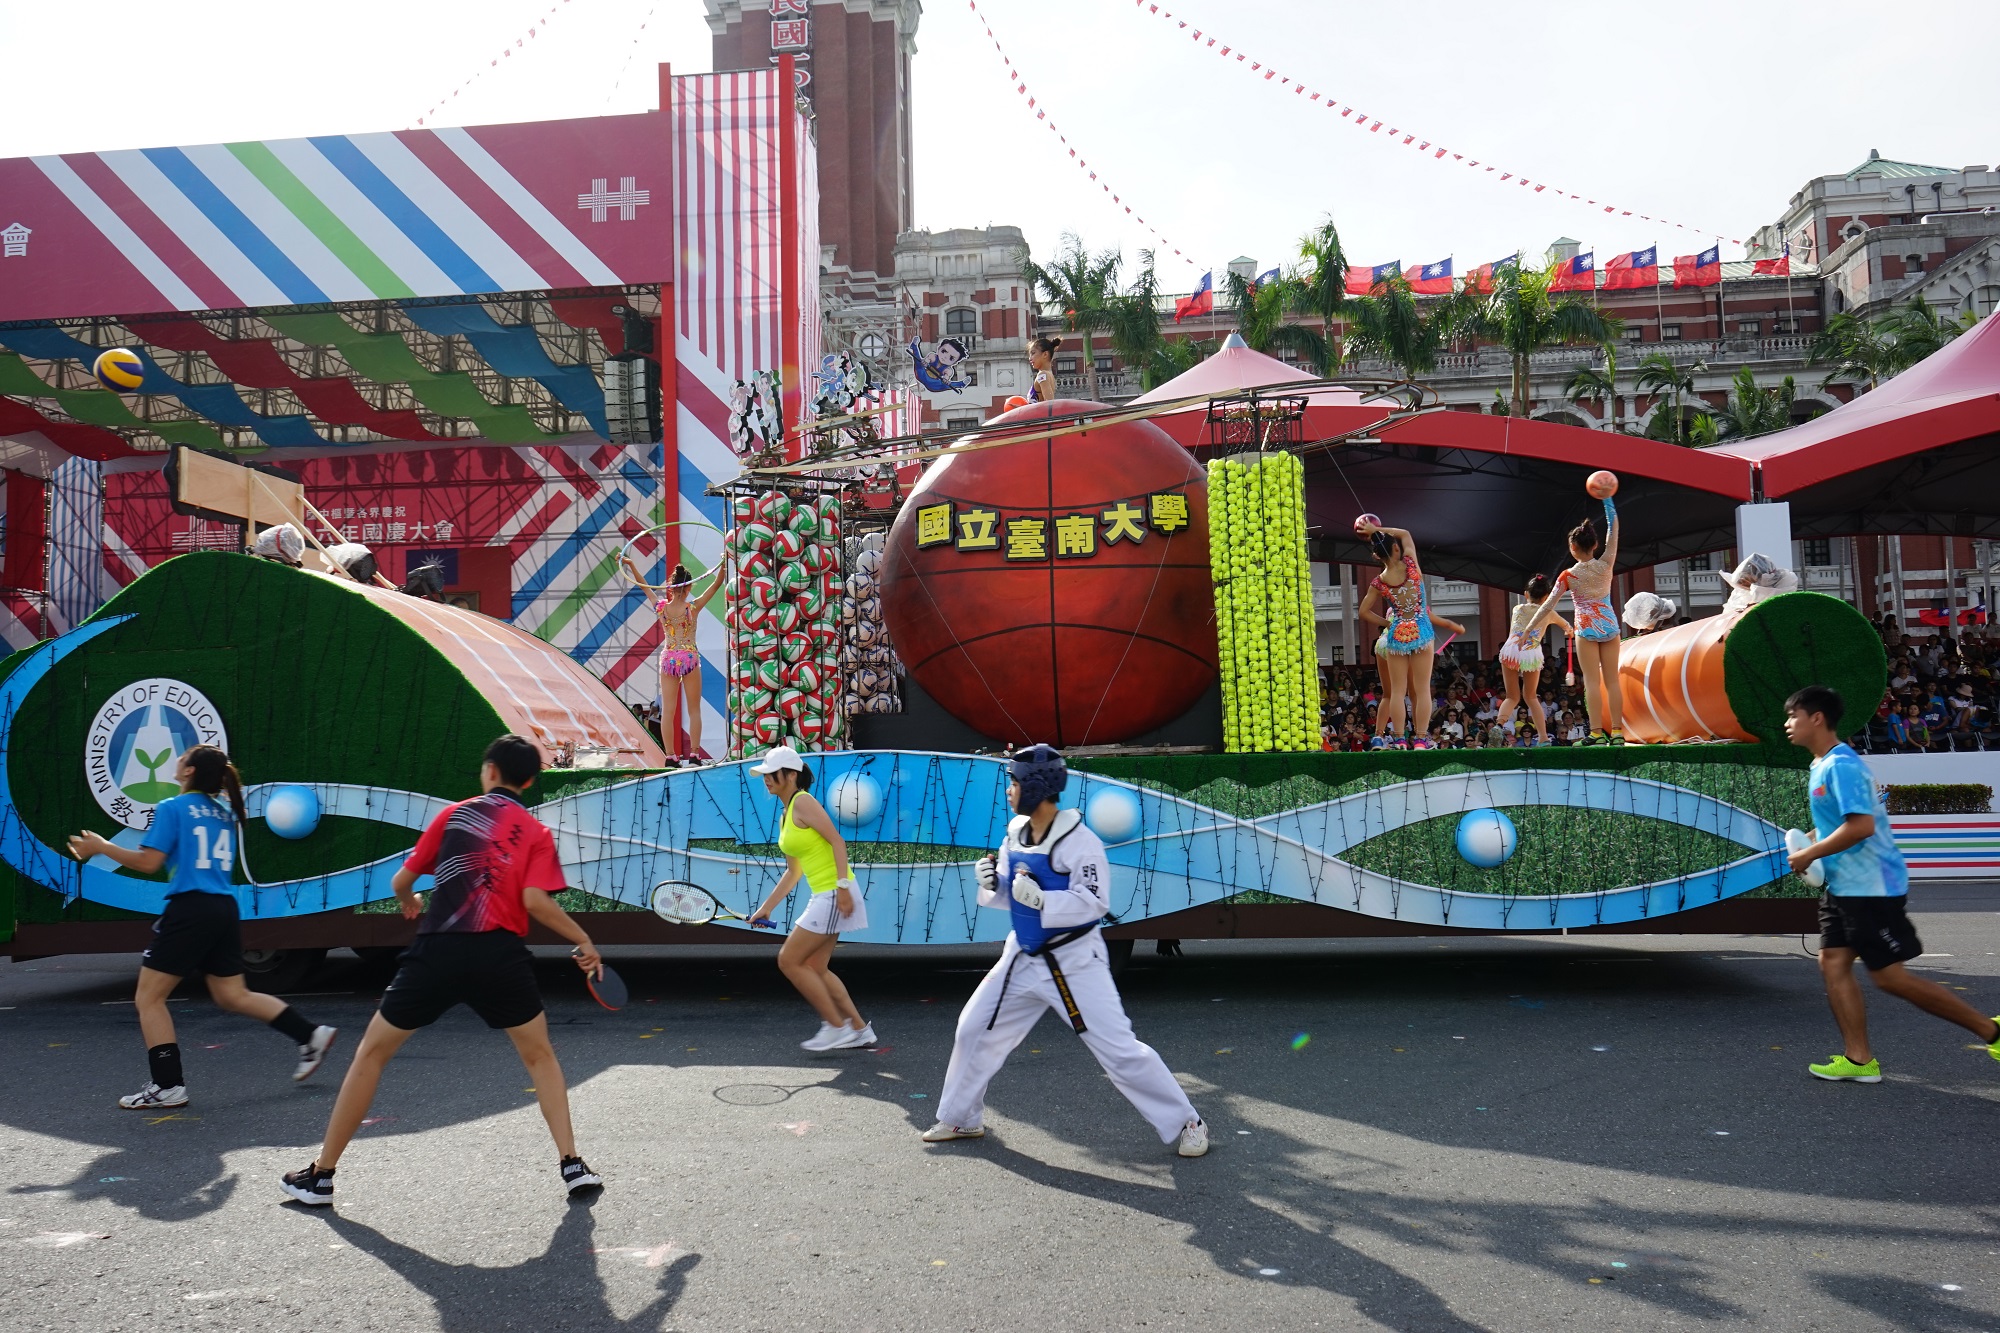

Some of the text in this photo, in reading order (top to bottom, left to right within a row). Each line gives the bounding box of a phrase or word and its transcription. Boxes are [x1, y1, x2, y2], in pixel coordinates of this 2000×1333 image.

[0, 222, 32, 257] 會
[304, 519, 454, 544] 六年國慶大會
[917, 493, 1188, 560] 國立臺南大學
[91, 696, 127, 794] MINISTRY
[133, 685, 159, 703] OF
[193, 825, 233, 872] 14
